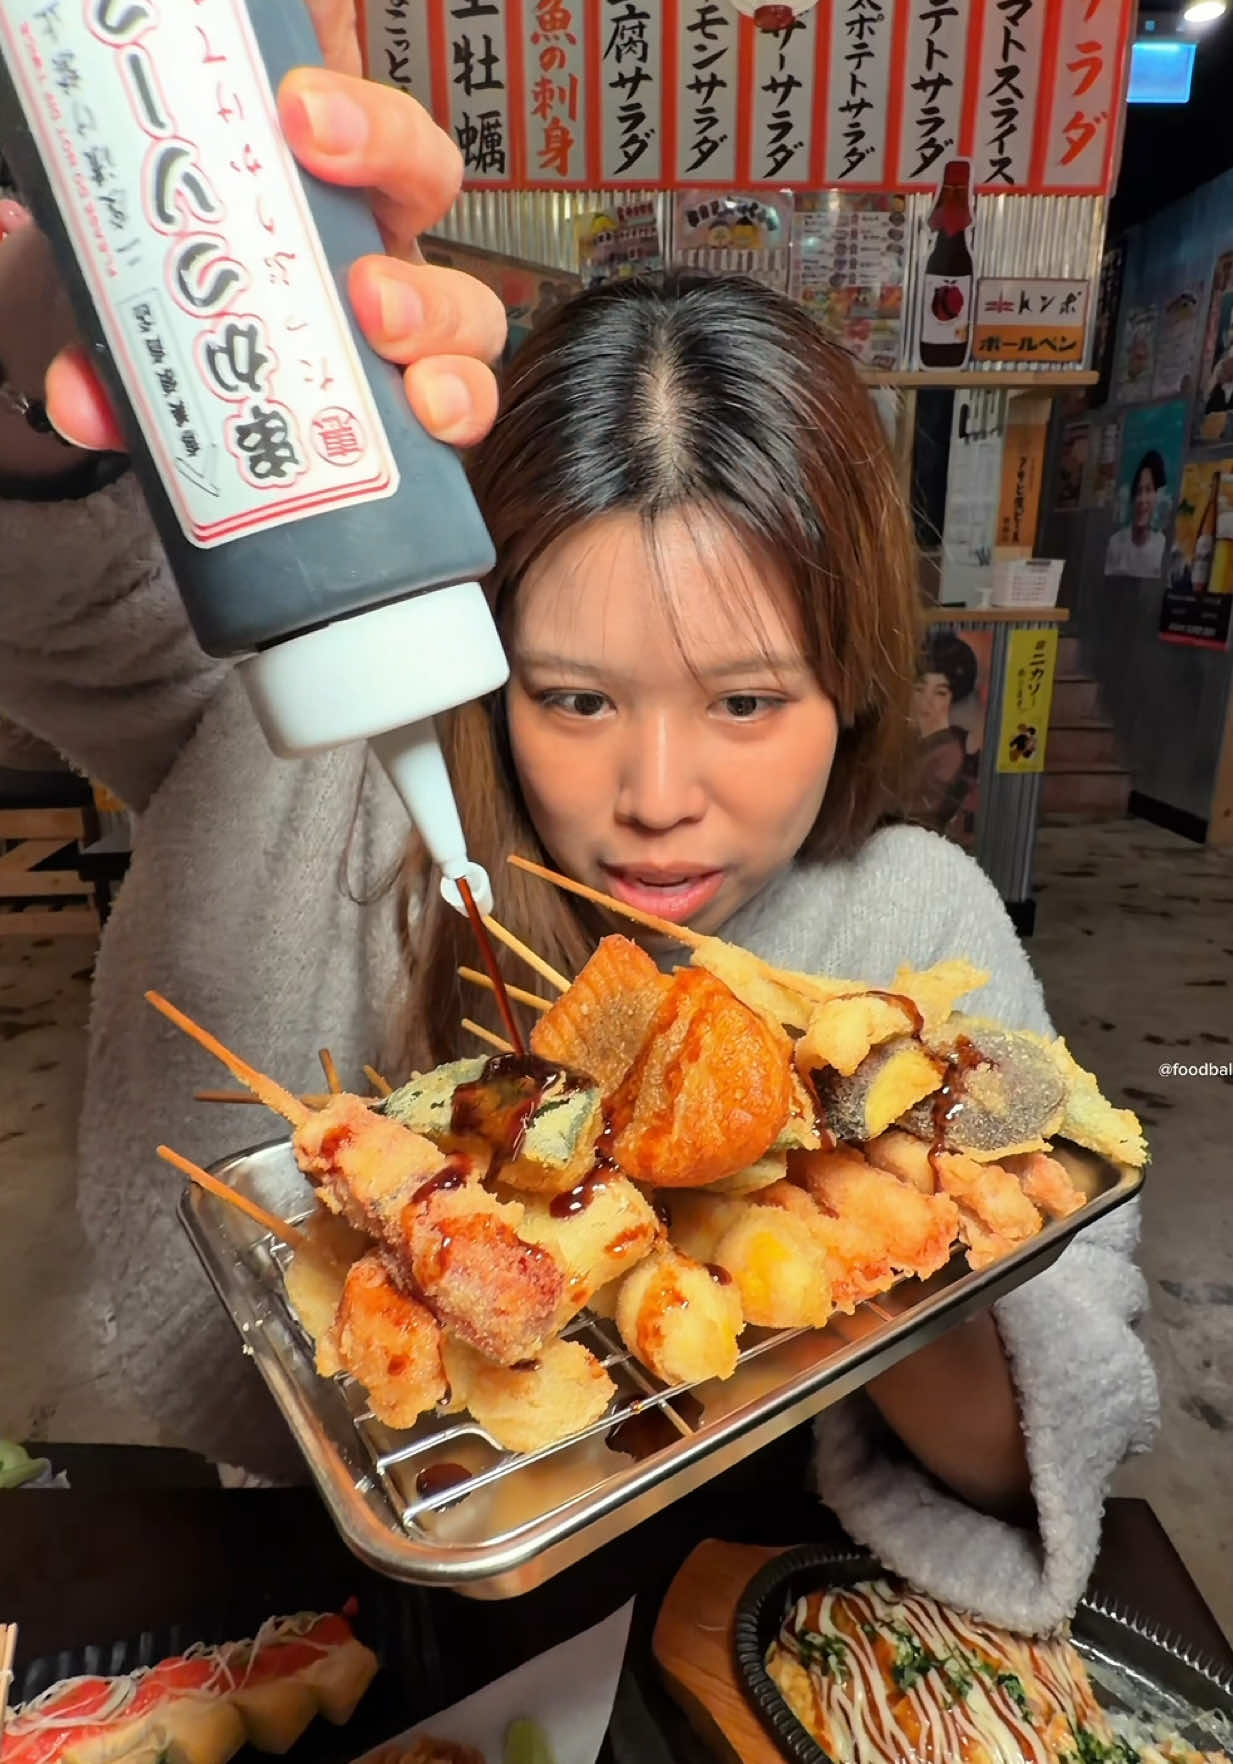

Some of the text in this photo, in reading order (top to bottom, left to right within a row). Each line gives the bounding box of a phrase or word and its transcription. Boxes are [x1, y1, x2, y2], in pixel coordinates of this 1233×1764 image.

[384, 0, 412, 91] こっと
[531, 0, 578, 177] 魚の刺身
[602, 0, 655, 175] 腐サラダ
[685, 0, 729, 173] モンサラダ
[910, 0, 959, 178] テトサラダ
[983, 0, 1033, 185] マトスライス
